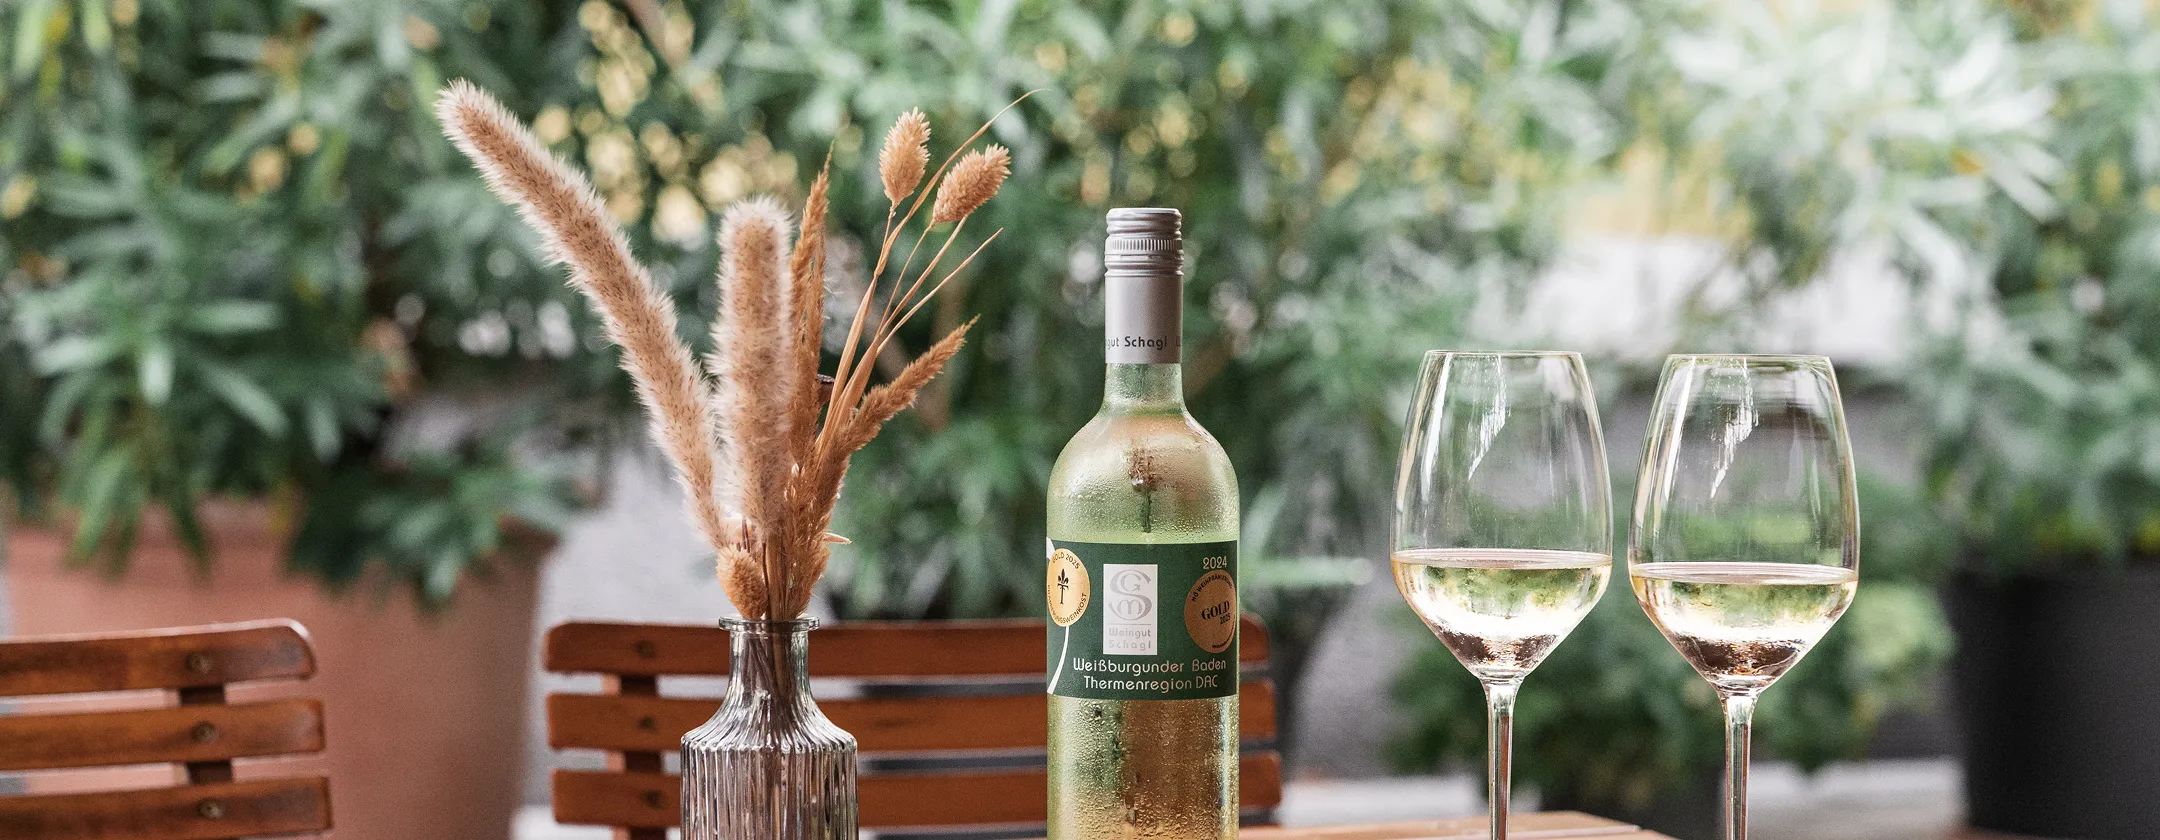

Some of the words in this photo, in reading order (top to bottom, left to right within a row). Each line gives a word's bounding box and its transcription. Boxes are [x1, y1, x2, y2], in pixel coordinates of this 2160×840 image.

[1124, 335, 1168, 351] Schagl
[1065, 553, 1081, 570] 2025
[1202, 555, 1228, 570] 2024
[1201, 600, 1231, 621] GOLD
[1108, 627, 1152, 639] Weingut
[1108, 639, 1152, 651] Schagl
[1073, 657, 1185, 677] Weißburgunder
[1191, 658, 1227, 672] Baden
[1083, 675, 1193, 694] Thermenregion
[1195, 674, 1219, 689] DAC
